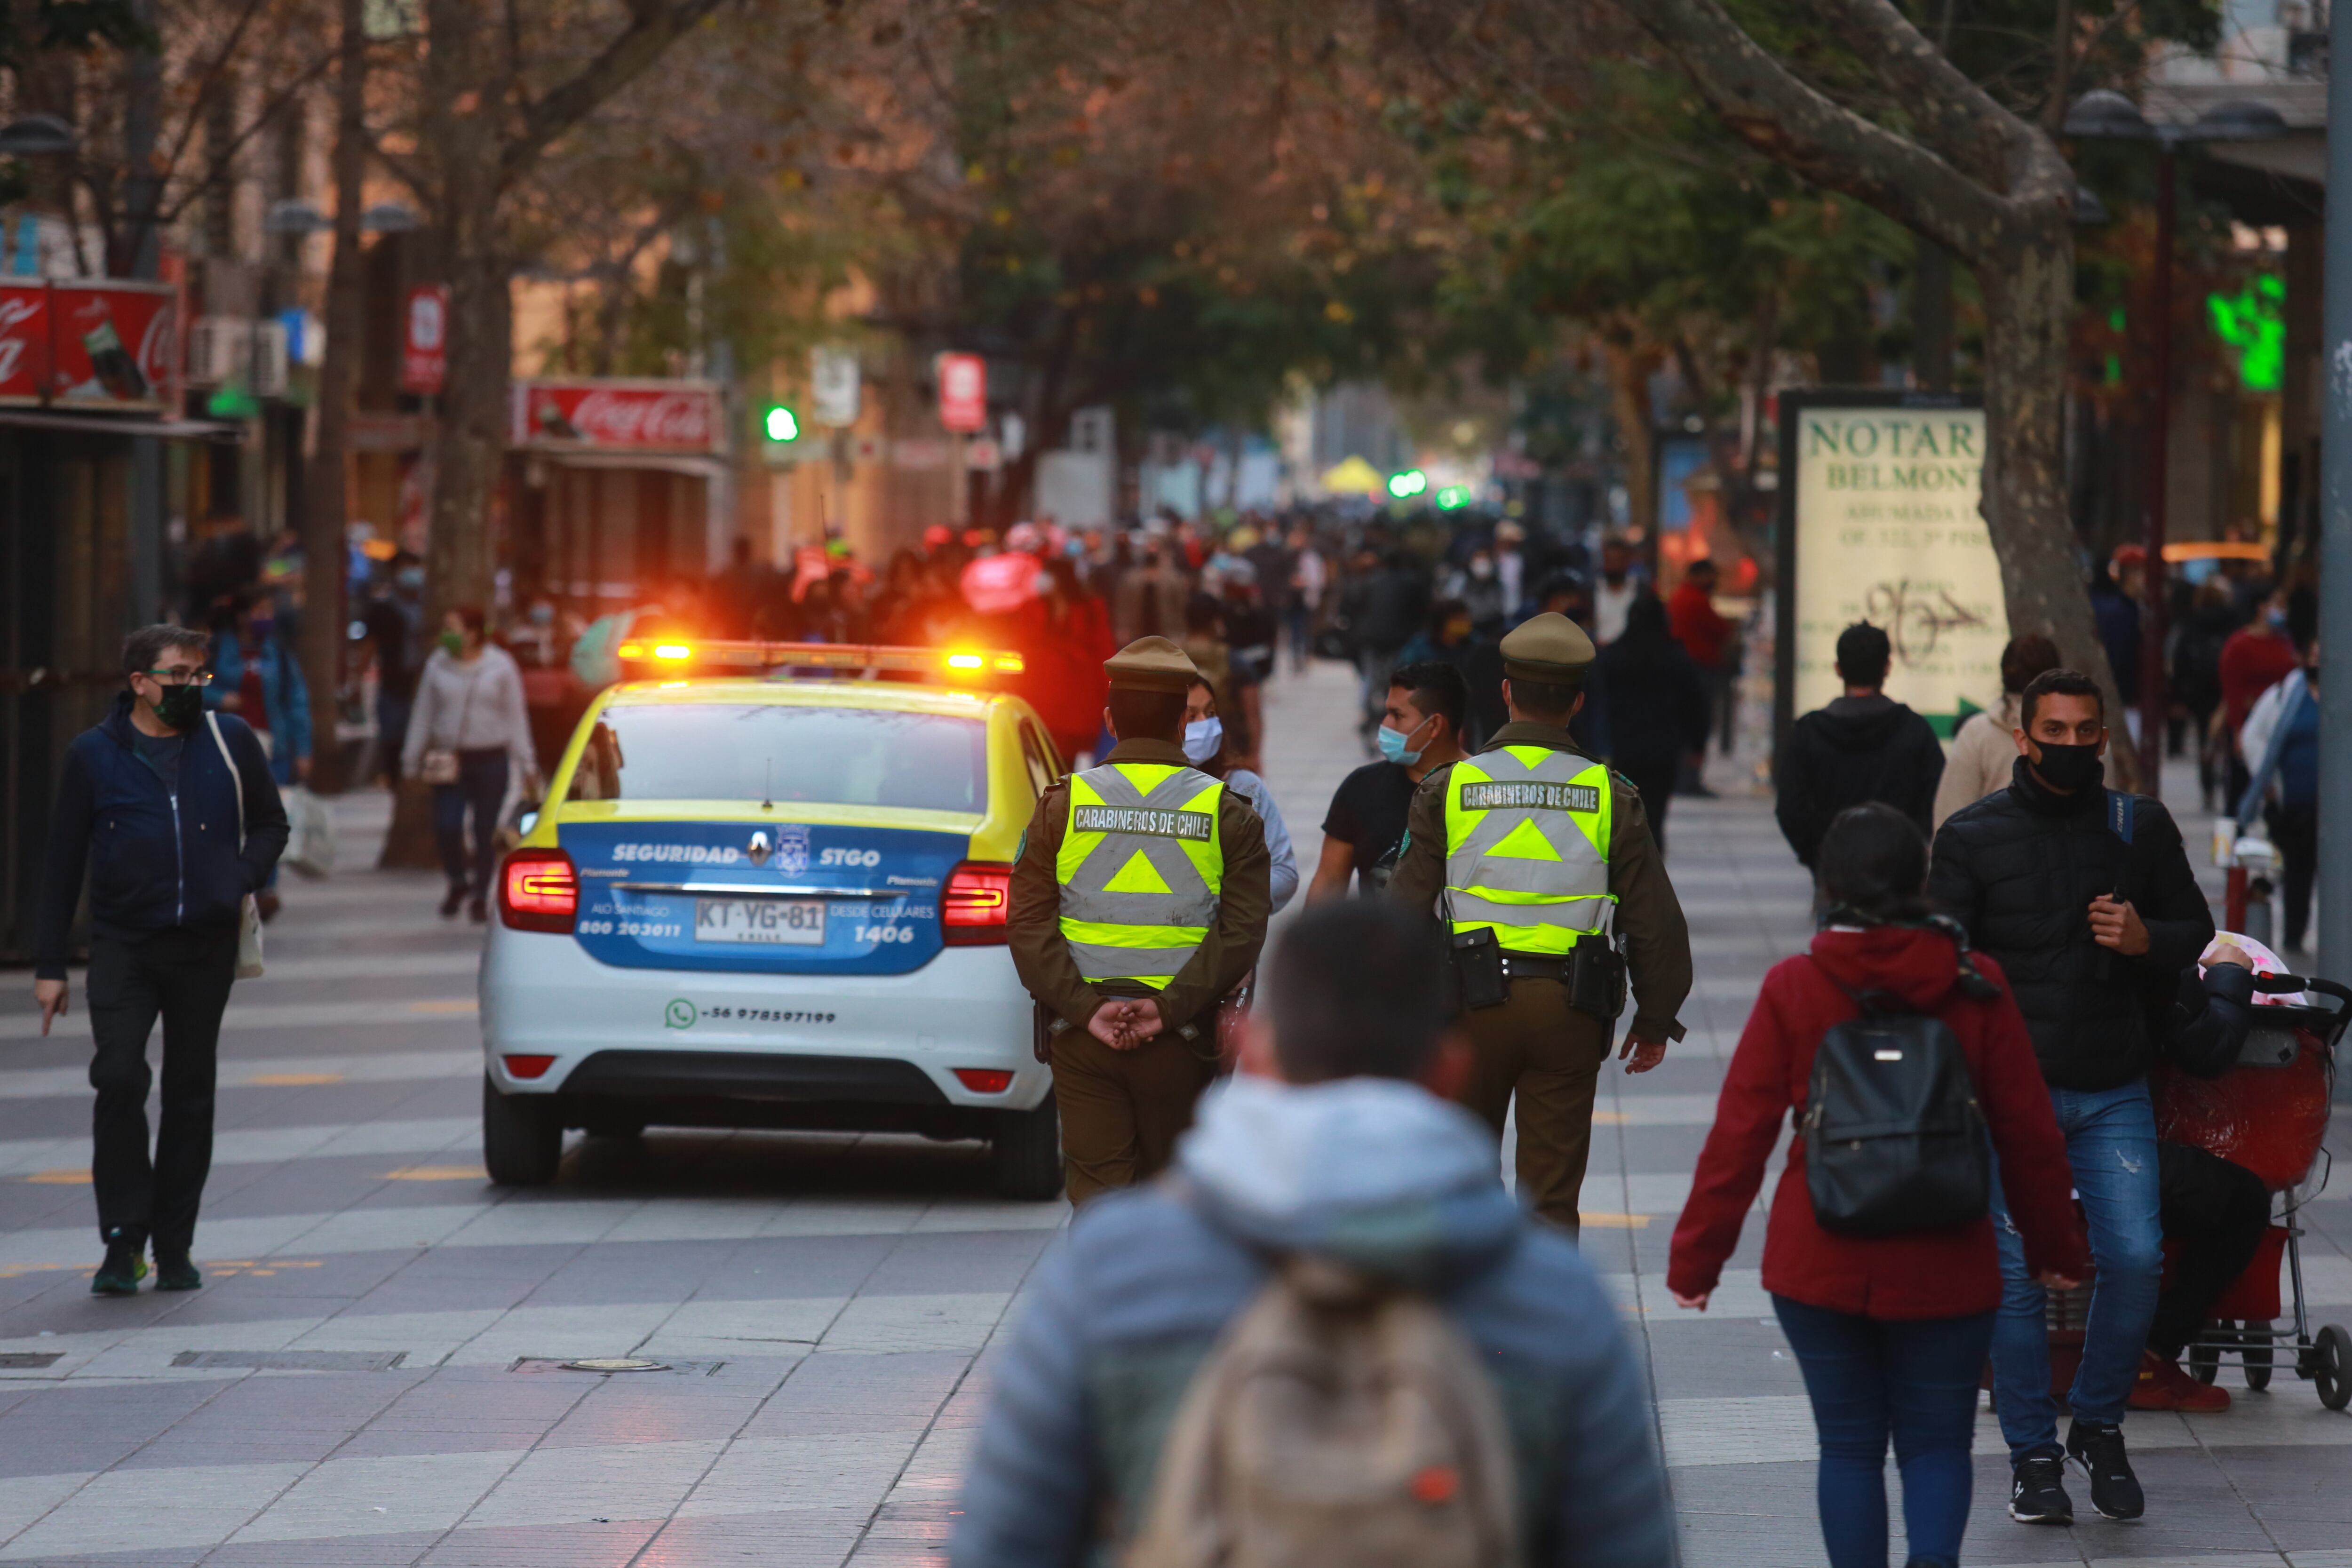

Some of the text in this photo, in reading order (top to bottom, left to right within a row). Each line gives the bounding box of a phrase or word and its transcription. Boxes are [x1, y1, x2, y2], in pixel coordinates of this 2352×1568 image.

[1463, 784, 1596, 809] CARABINEROS DE CHILE
[1076, 809, 1210, 838] CARABINEROS DE CHILE
[612, 844, 739, 863] SEGURIDAD
[820, 848, 881, 867] STGO
[614, 903, 670, 917] SANTIAGO
[830, 905, 934, 919] DESDE CELULARES
[579, 920, 681, 937] 800 203011
[855, 925, 914, 944] 1406
